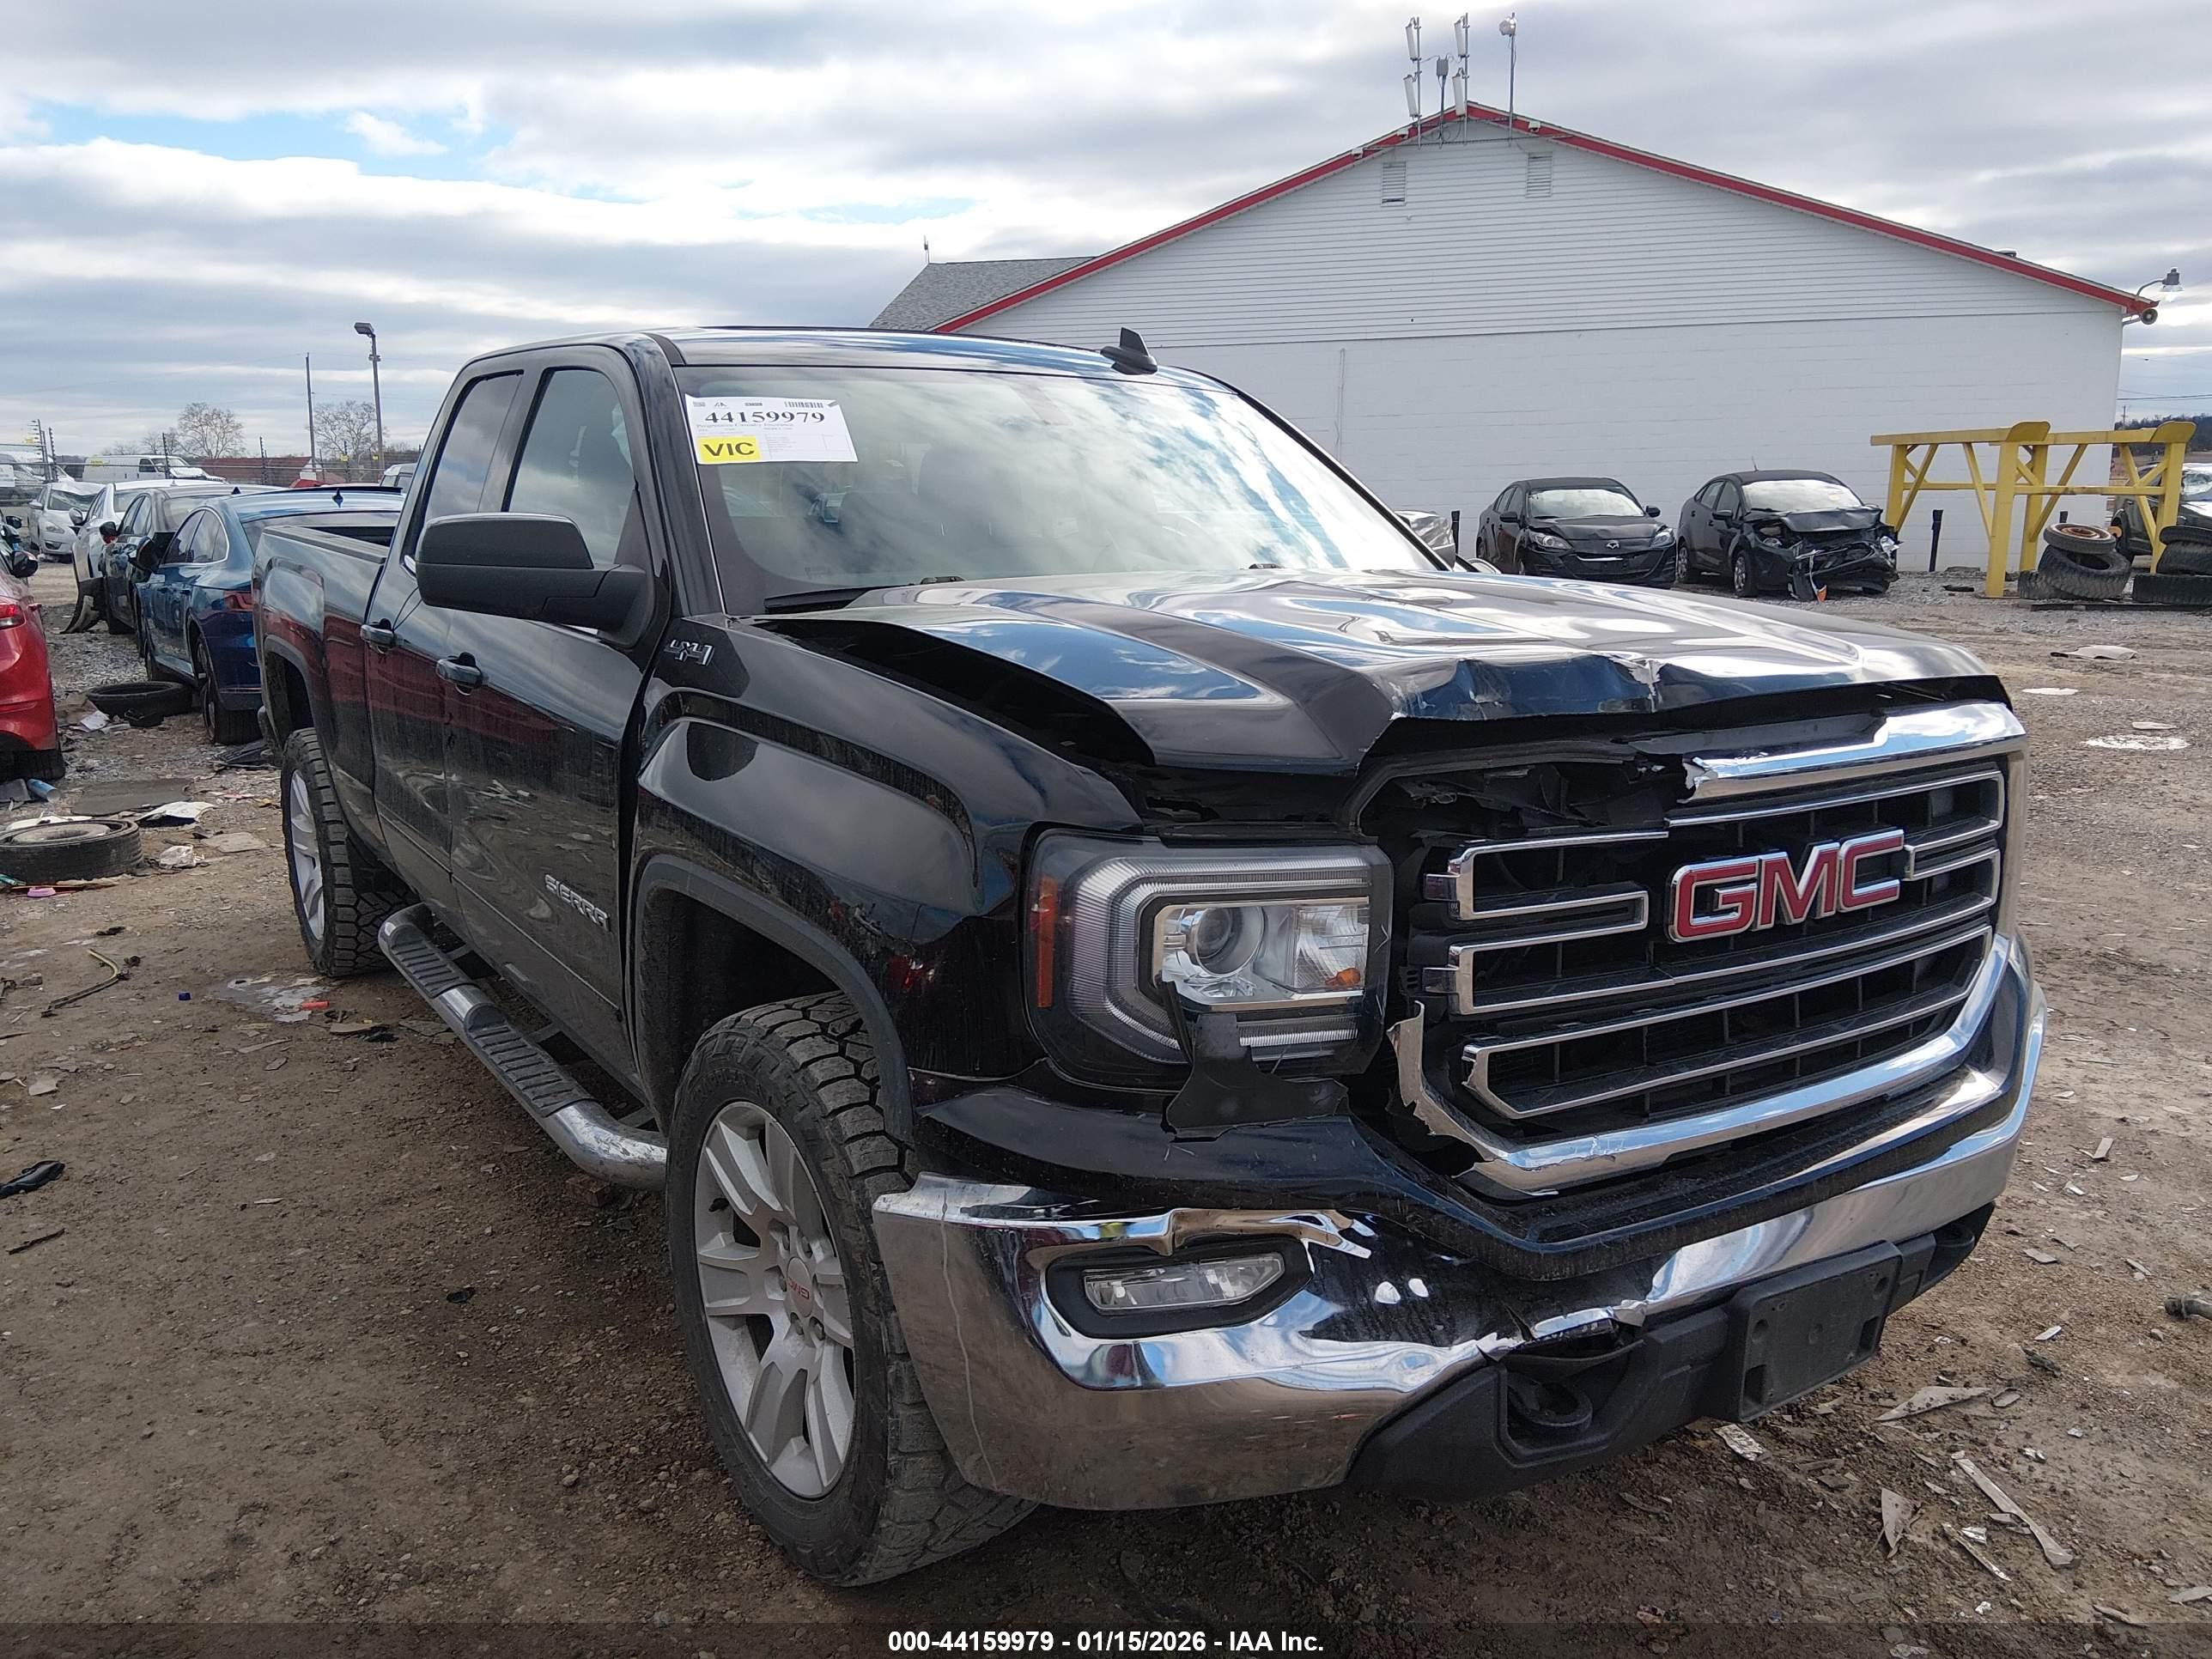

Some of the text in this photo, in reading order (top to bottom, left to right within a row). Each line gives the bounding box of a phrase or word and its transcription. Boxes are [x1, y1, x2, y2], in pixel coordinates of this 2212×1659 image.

[705, 411, 825, 422] 44159979
[703, 442, 755, 457] VIC
[544, 873, 608, 932] SIERRA
[1668, 829, 1905, 943] GMC
